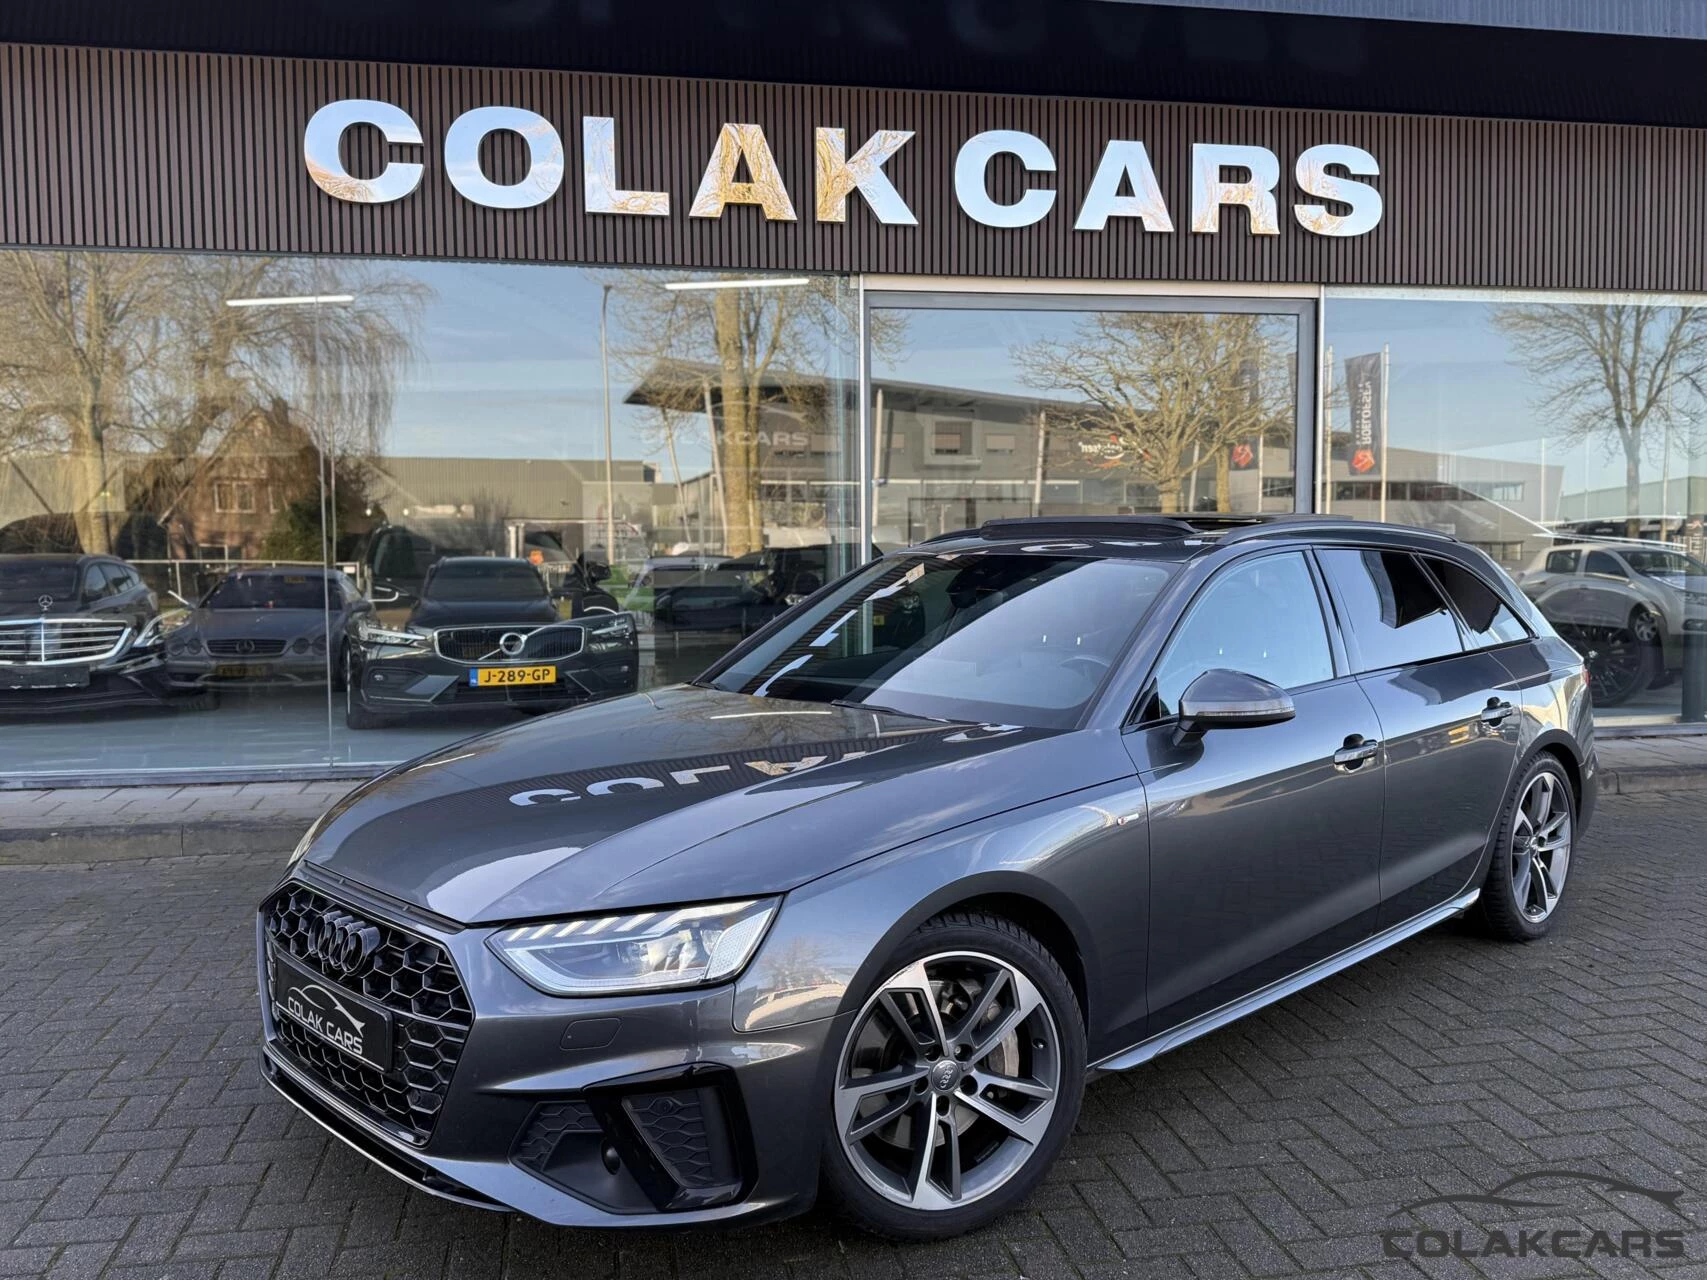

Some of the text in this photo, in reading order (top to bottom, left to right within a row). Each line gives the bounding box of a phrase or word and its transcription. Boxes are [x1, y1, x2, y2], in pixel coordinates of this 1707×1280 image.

[303, 98, 1384, 238] COLAK CARS
[484, 668, 551, 683] J-289-GP
[288, 996, 363, 1055] COLAK CARS
